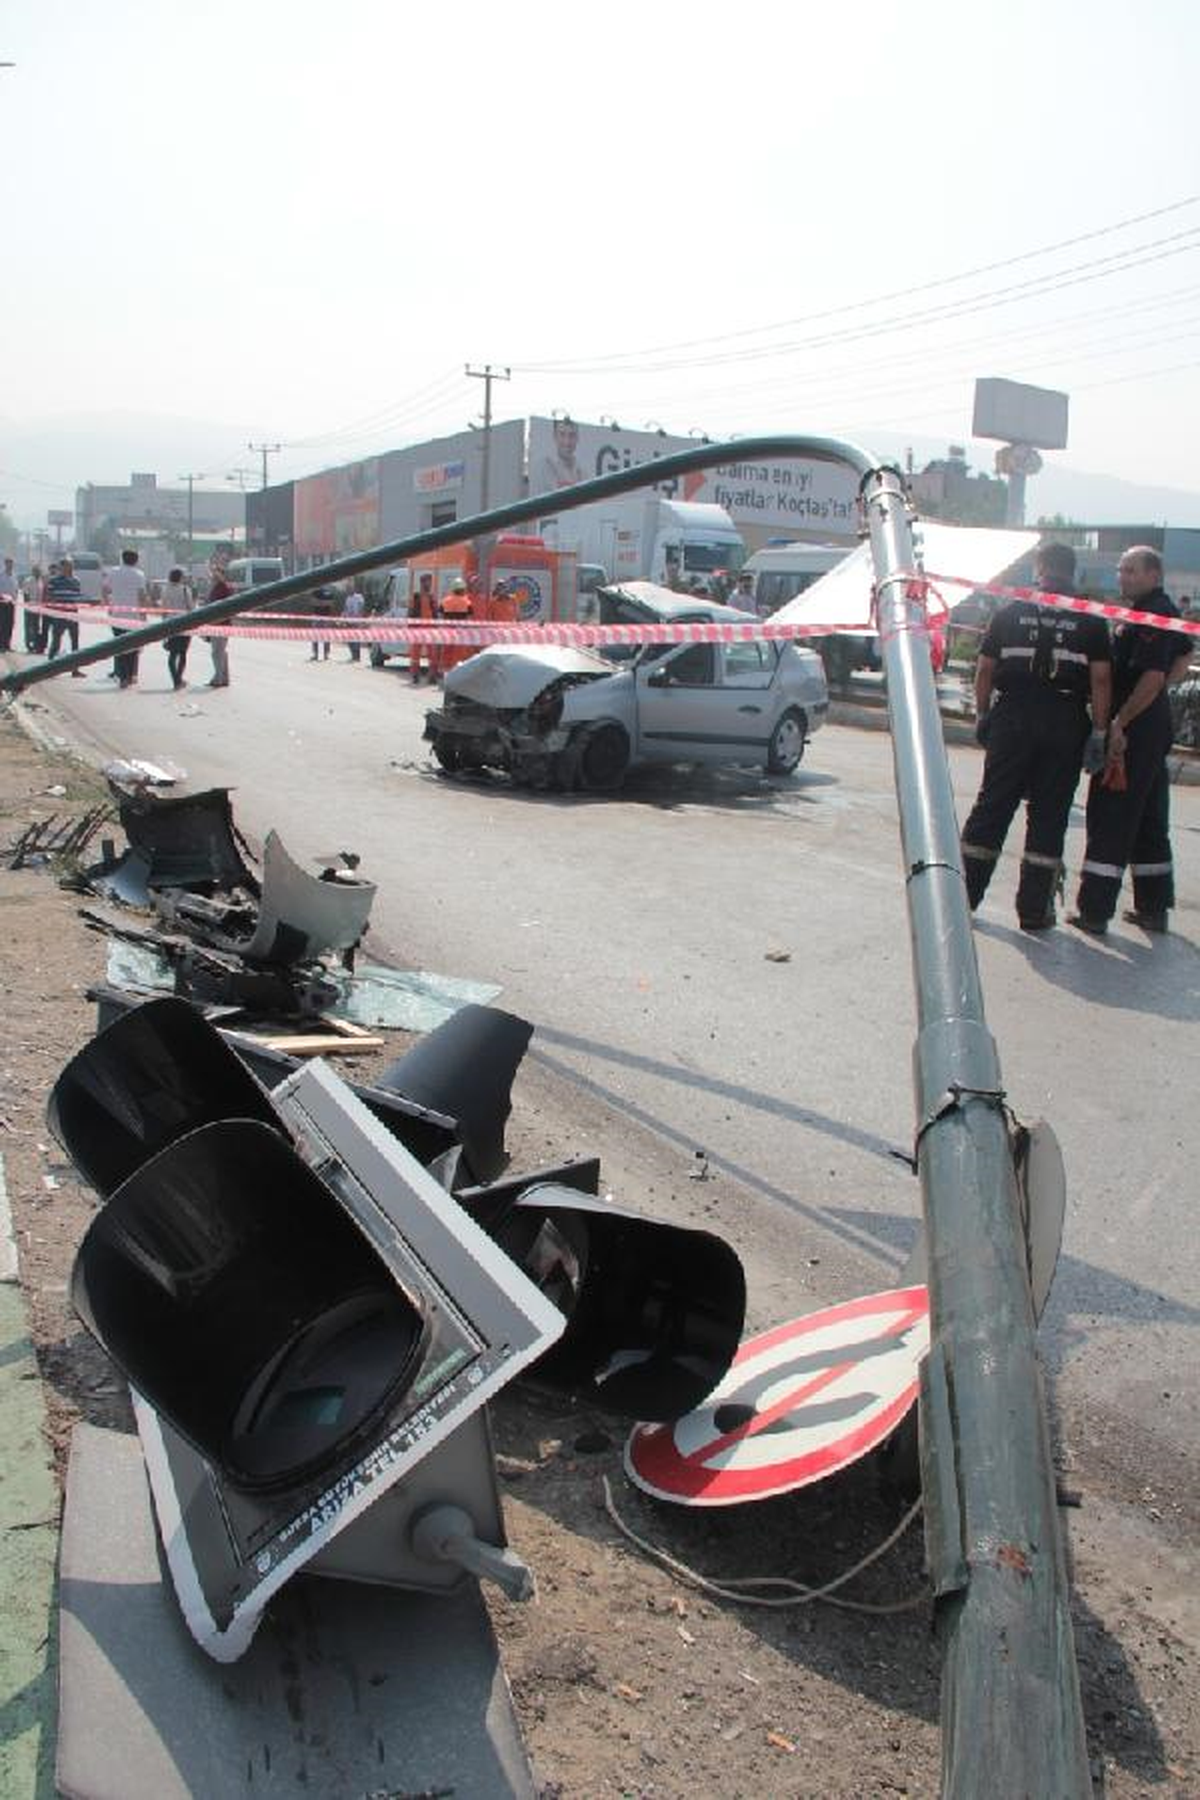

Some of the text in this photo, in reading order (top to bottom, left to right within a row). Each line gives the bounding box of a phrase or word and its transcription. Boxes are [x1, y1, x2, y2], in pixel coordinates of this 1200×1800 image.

[773, 469, 792, 485] en
[714, 485, 775, 511] fiyatlar
[309, 1479, 365, 1533] ARIZA
